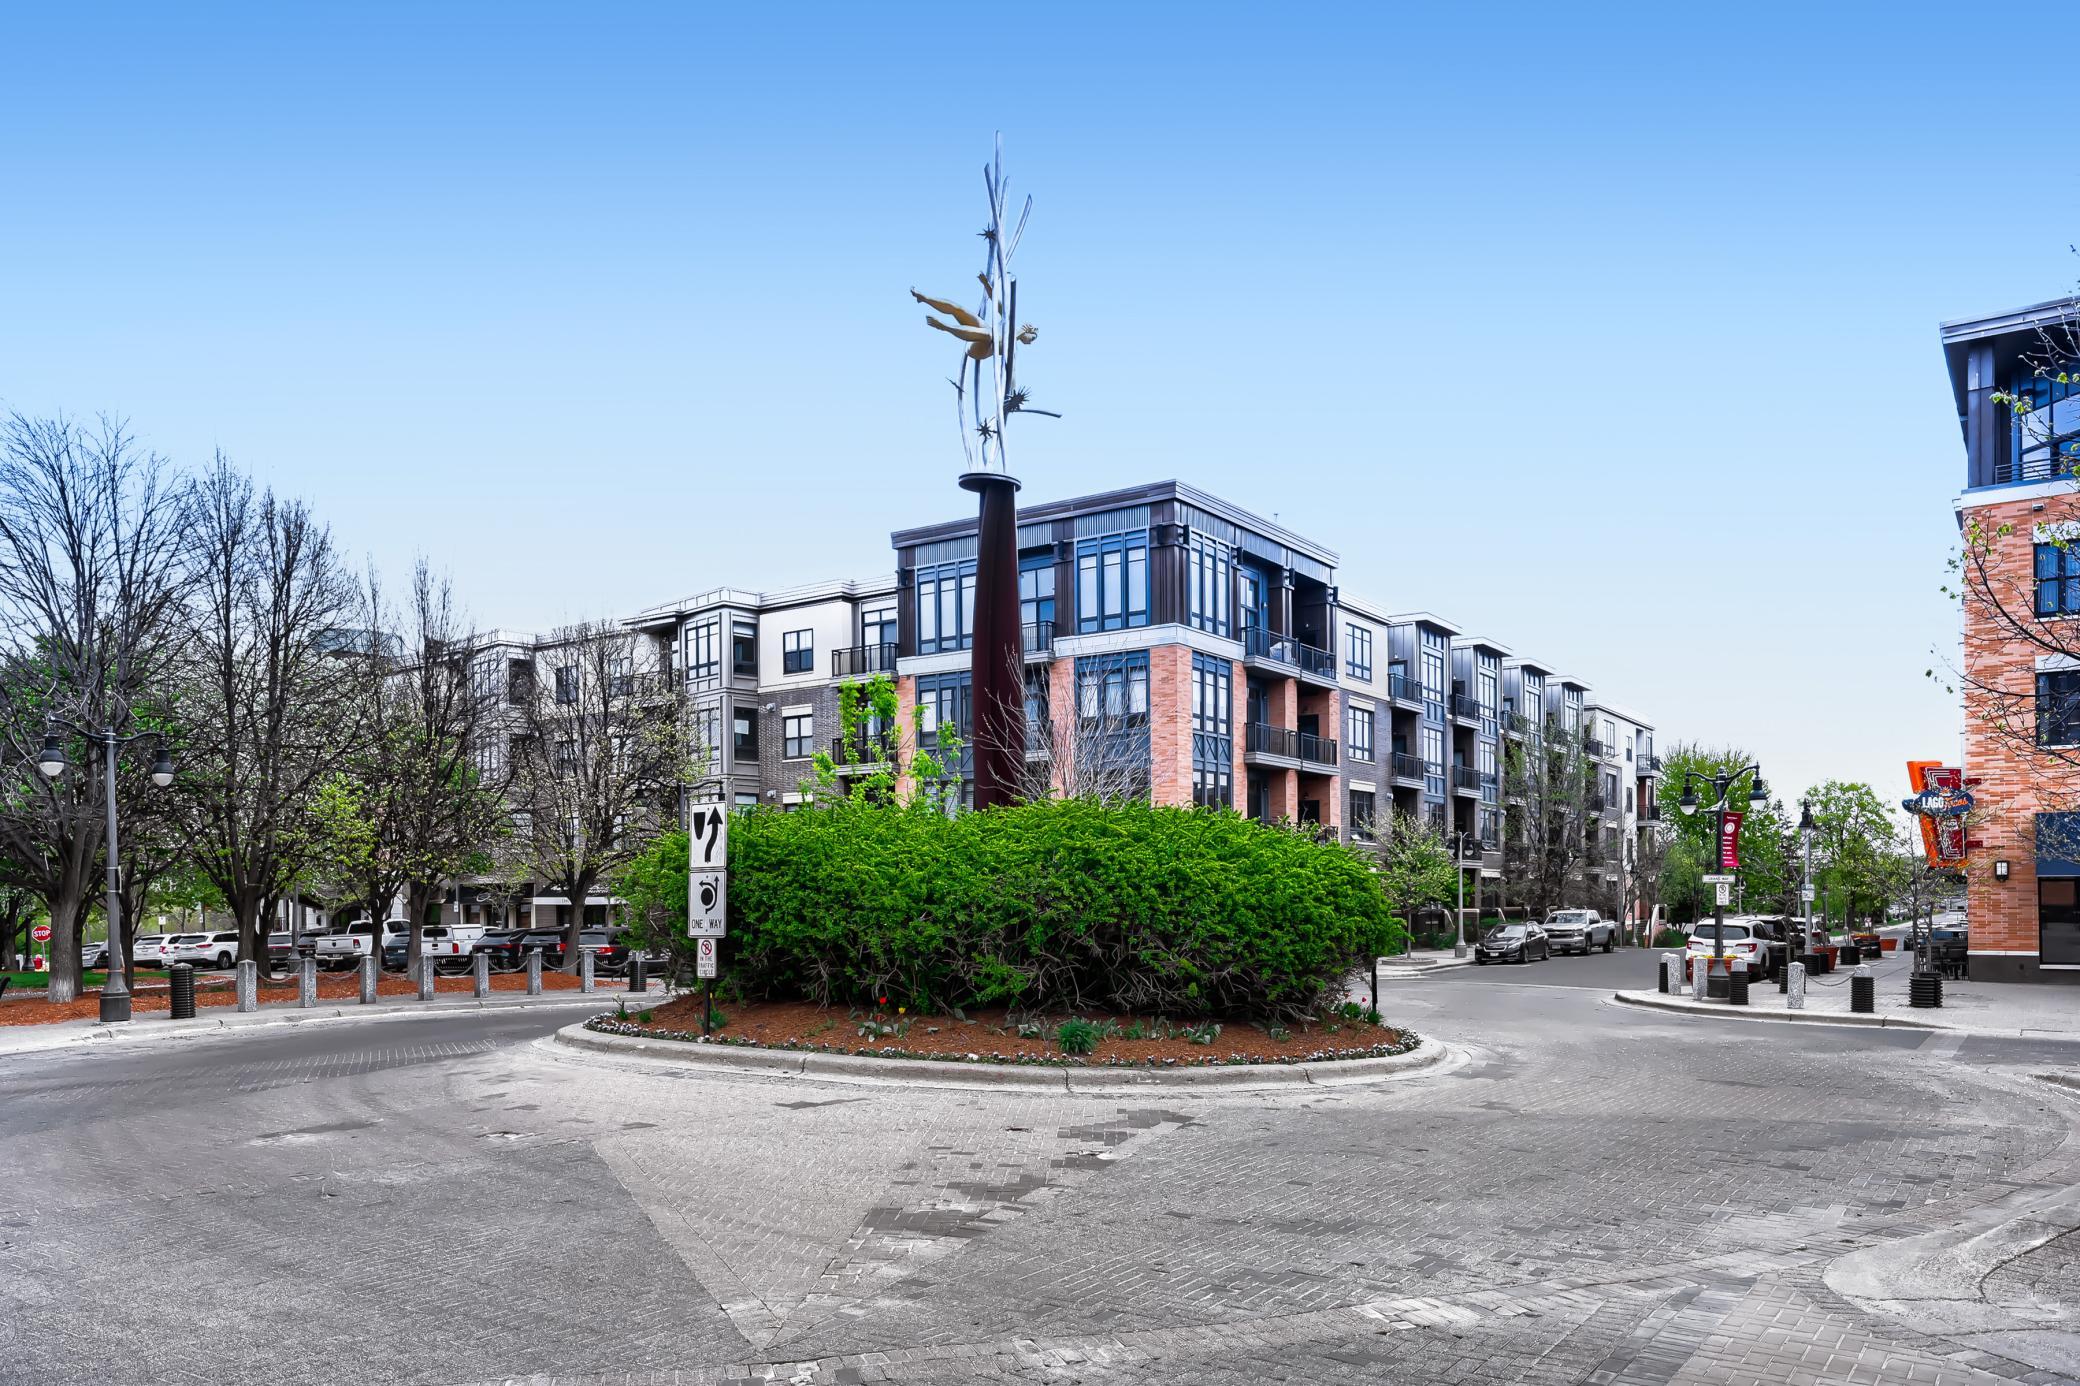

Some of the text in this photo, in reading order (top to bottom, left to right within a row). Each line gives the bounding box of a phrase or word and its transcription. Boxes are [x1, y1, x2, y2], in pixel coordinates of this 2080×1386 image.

[1922, 796, 1944, 808] LAGO
[691, 919, 722, 929] ONE WAY
